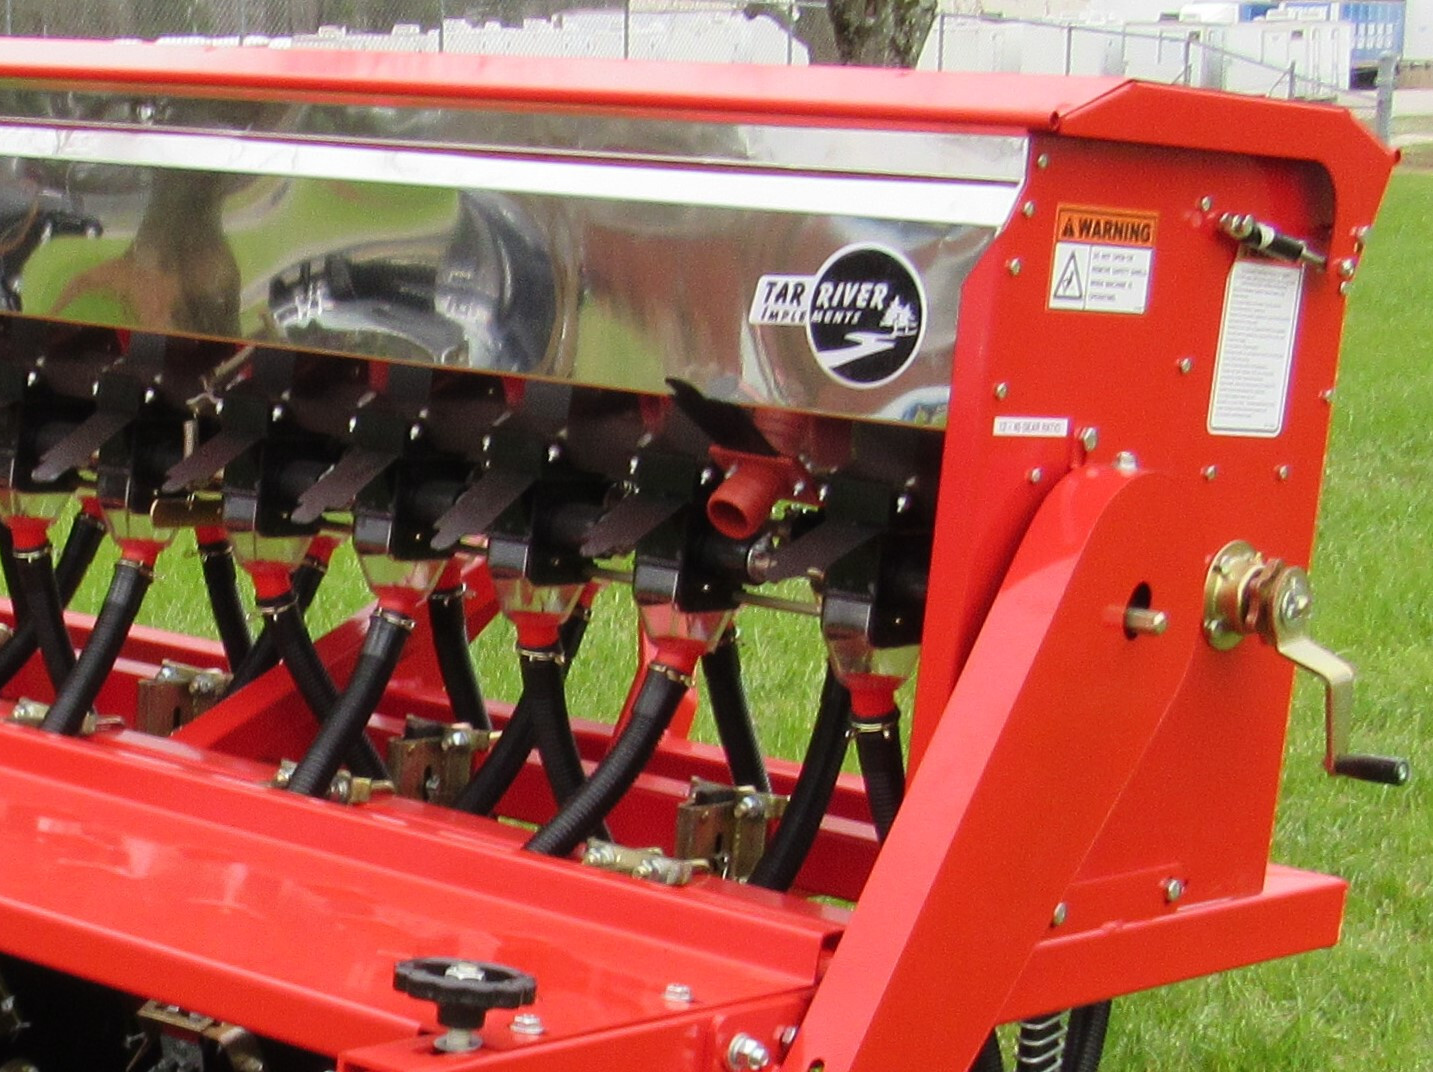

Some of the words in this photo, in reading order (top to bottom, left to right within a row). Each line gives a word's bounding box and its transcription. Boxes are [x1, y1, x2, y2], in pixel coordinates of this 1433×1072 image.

[1079, 217, 1152, 243] WARNING
[764, 281, 807, 306] TAR
[816, 281, 890, 311] RIVER
